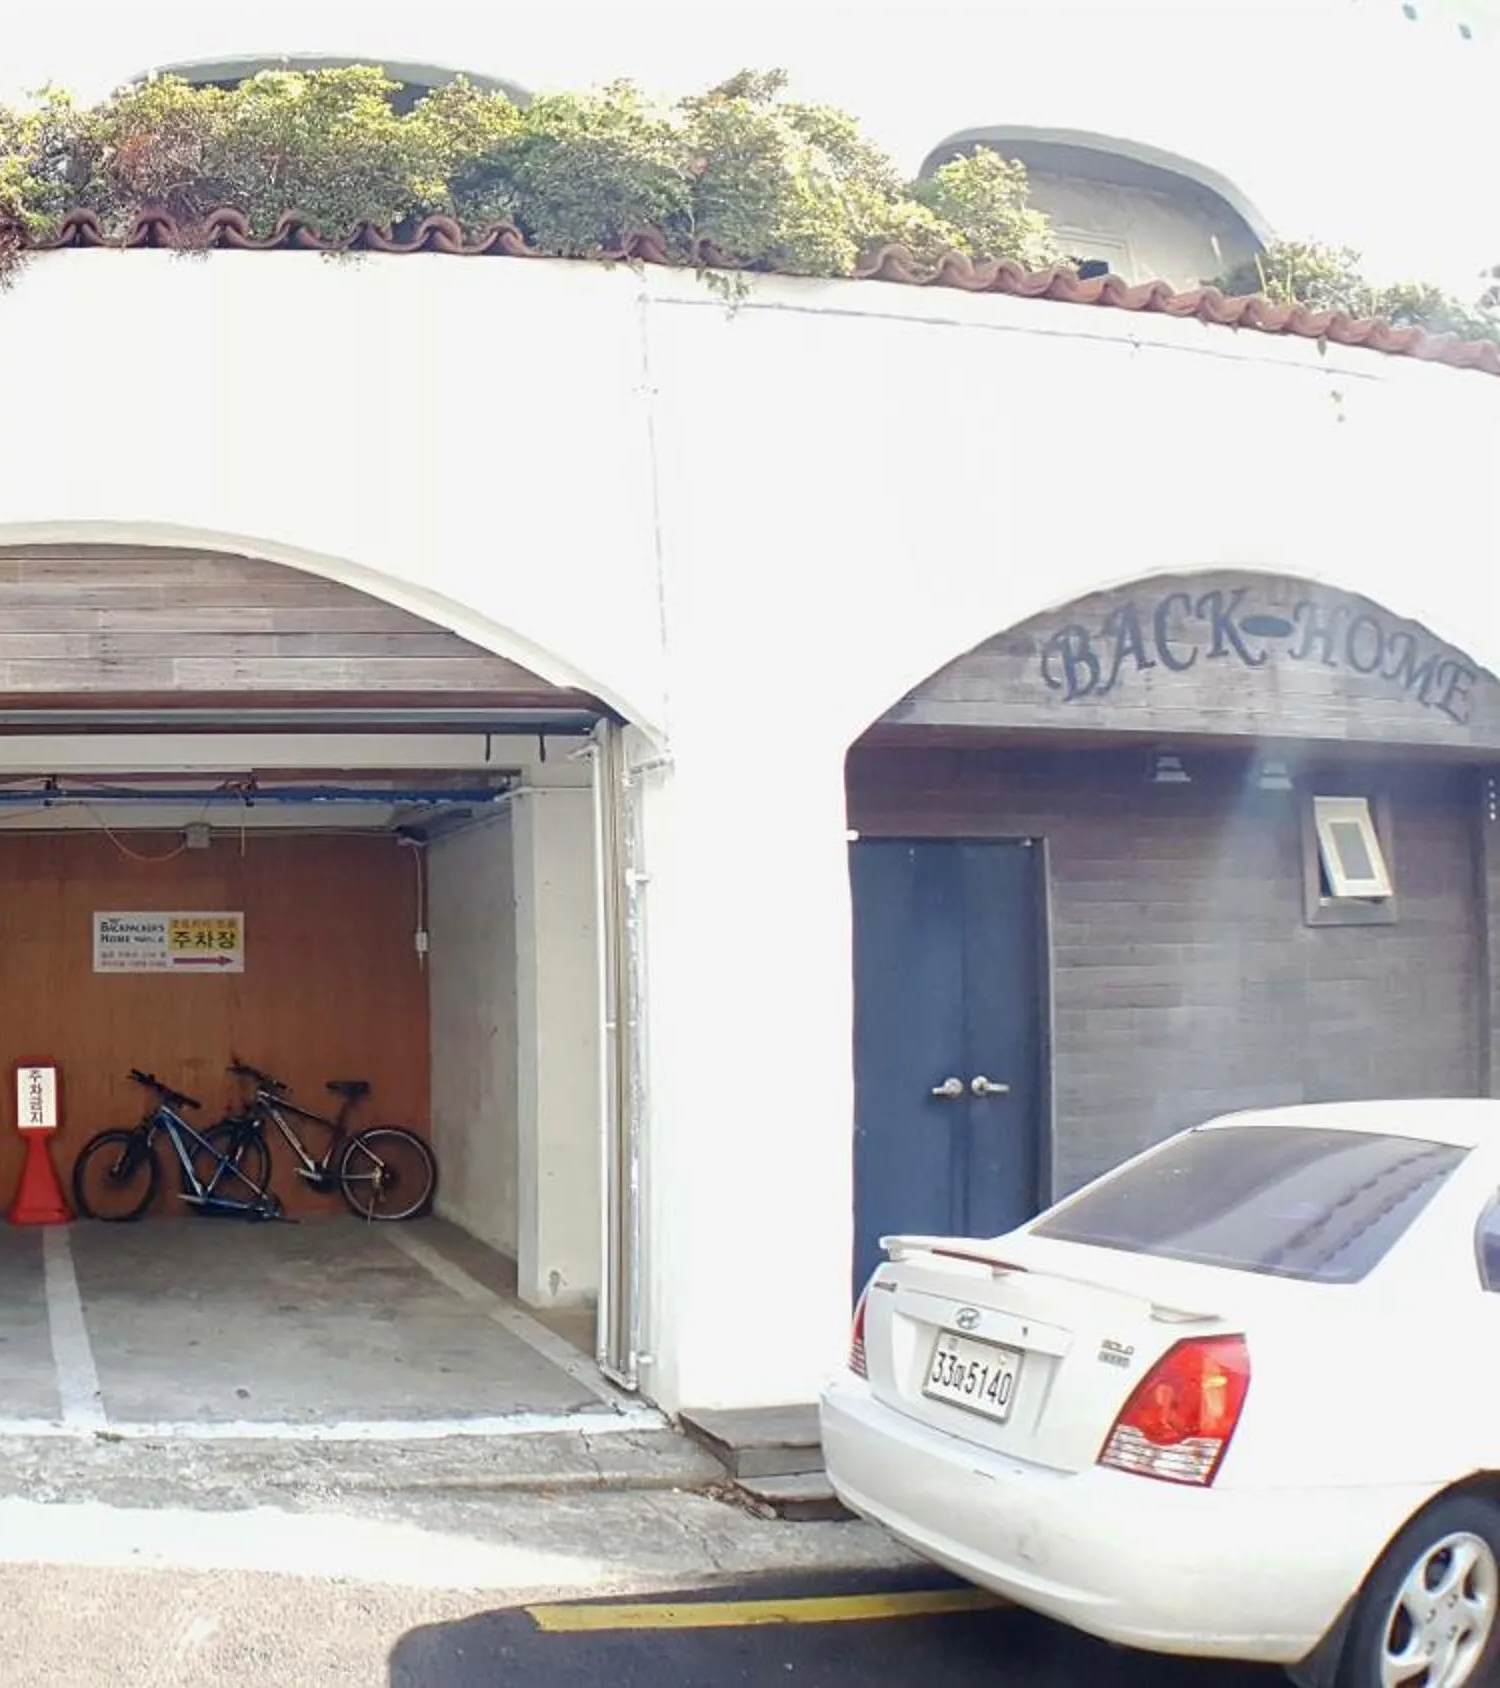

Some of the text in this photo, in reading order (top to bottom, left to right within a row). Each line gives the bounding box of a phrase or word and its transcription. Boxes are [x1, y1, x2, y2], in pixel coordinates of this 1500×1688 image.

[1041, 588, 1478, 725] BACK HOME
[173, 930, 235, 949] 주차장
[28, 1069, 44, 1124] 주차금지
